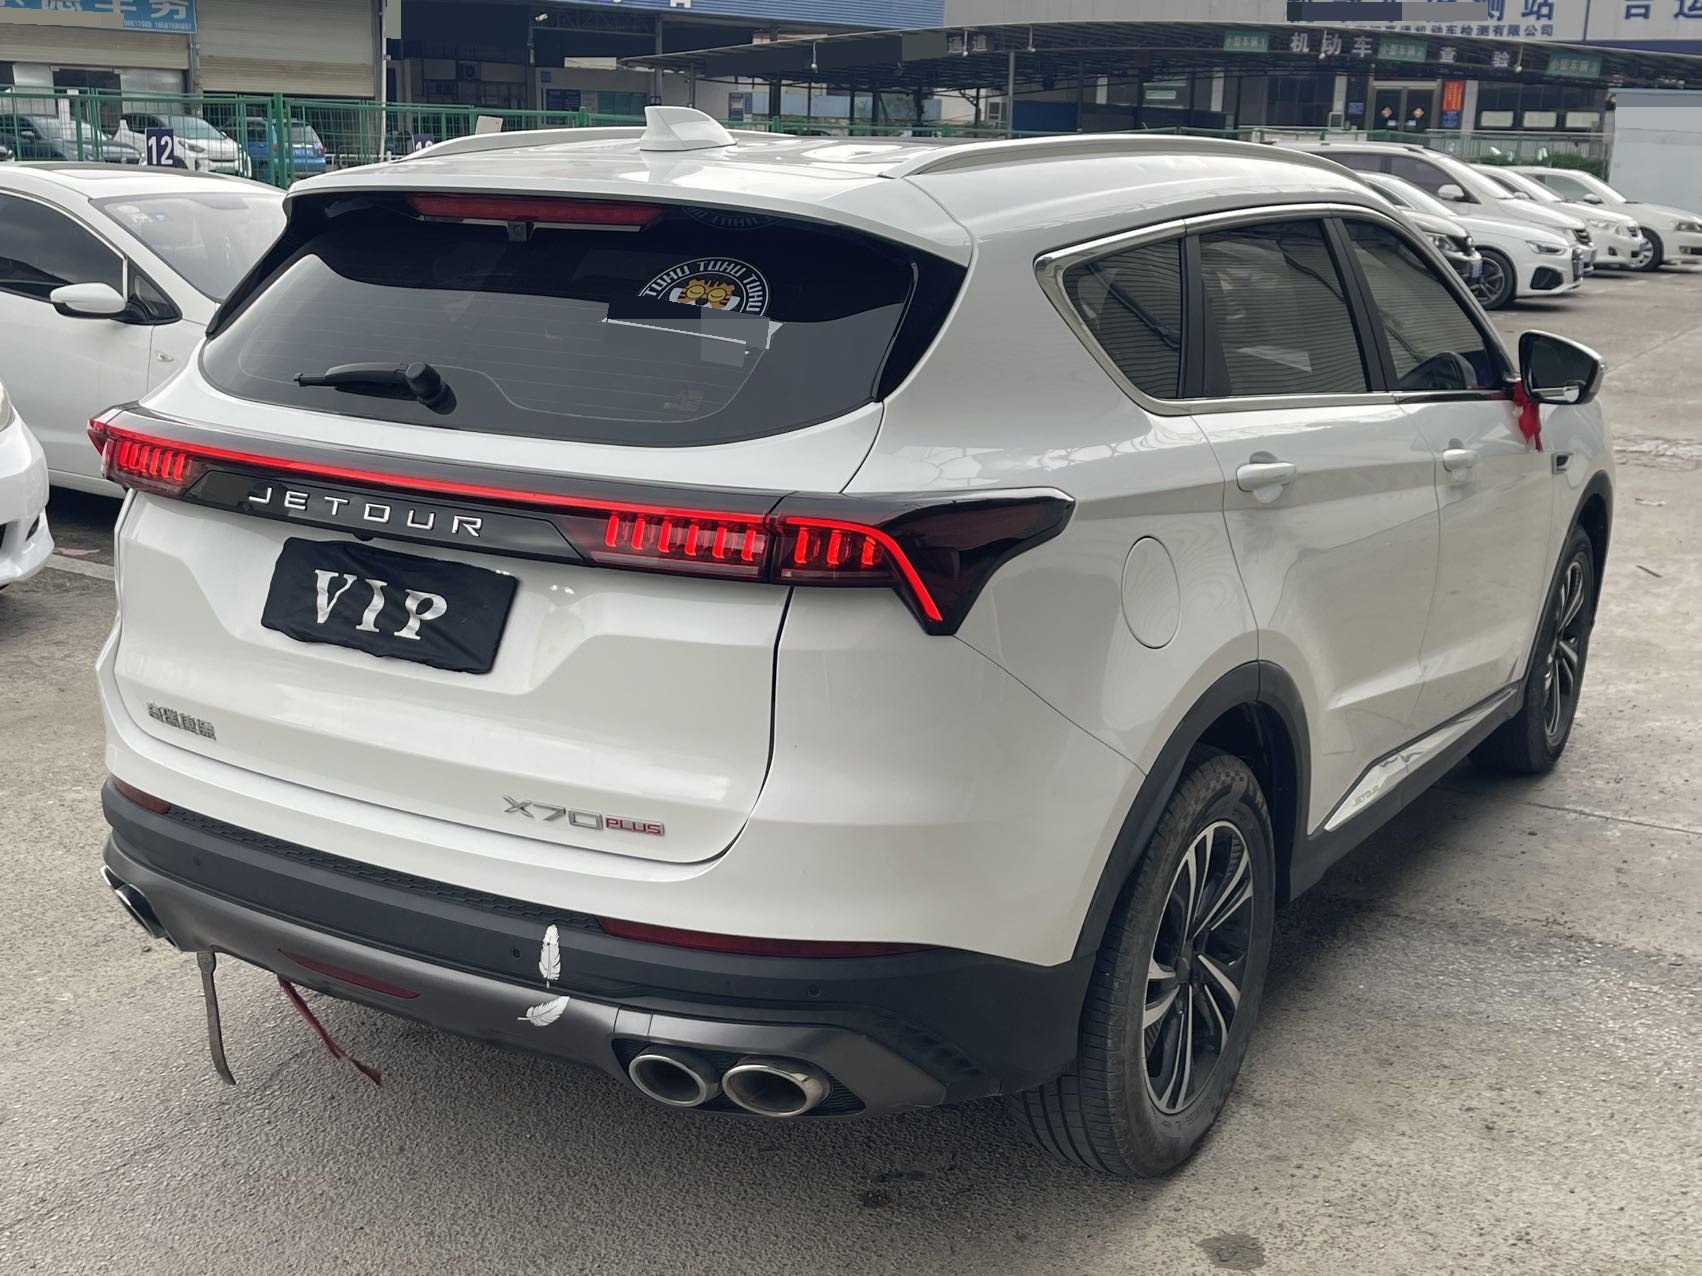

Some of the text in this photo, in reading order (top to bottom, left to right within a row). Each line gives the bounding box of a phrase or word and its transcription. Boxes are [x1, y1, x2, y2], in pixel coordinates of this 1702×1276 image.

[1290, 32, 1374, 58] 机动车
[148, 136, 174, 165] 12
[642, 260, 763, 312] TUHU TUHU TUHU
[248, 486, 483, 538] JETOUR
[314, 569, 448, 641] VIP
[502, 794, 665, 837] X70 PLUS
